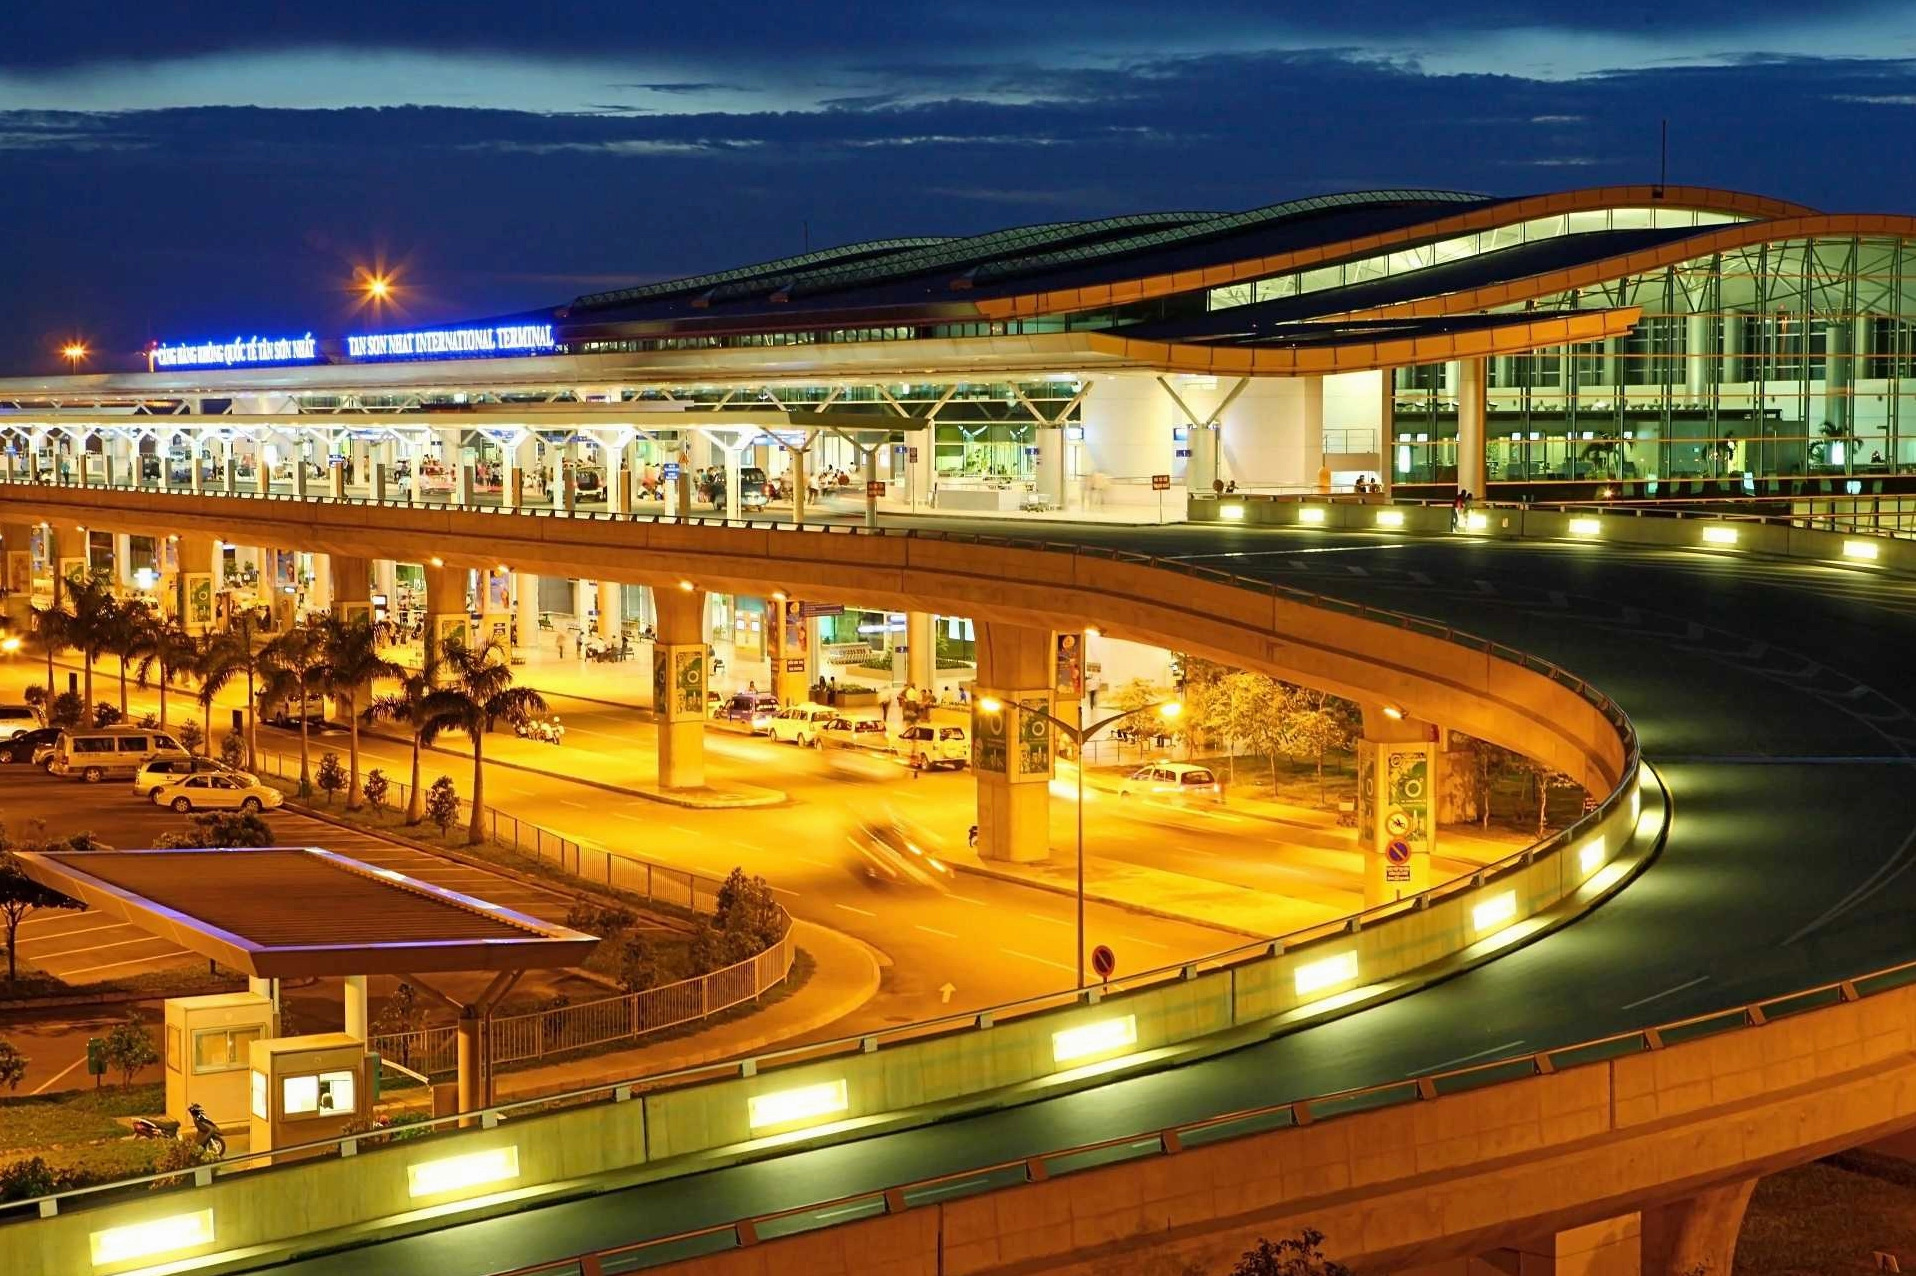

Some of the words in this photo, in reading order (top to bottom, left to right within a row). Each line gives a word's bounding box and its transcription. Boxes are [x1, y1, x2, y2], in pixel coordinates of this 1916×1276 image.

[224, 336, 246, 365] QUỐC
[246, 335, 257, 361] TẾ
[257, 338, 273, 360] TÂN
[292, 332, 315, 359] NHẤT
[348, 336, 366, 356] TAN
[367, 335, 387, 355] SON
[387, 333, 414, 354] NHAT
[415, 328, 496, 353] INTERNATIONAL
[496, 325, 554, 349] TERMINAL
